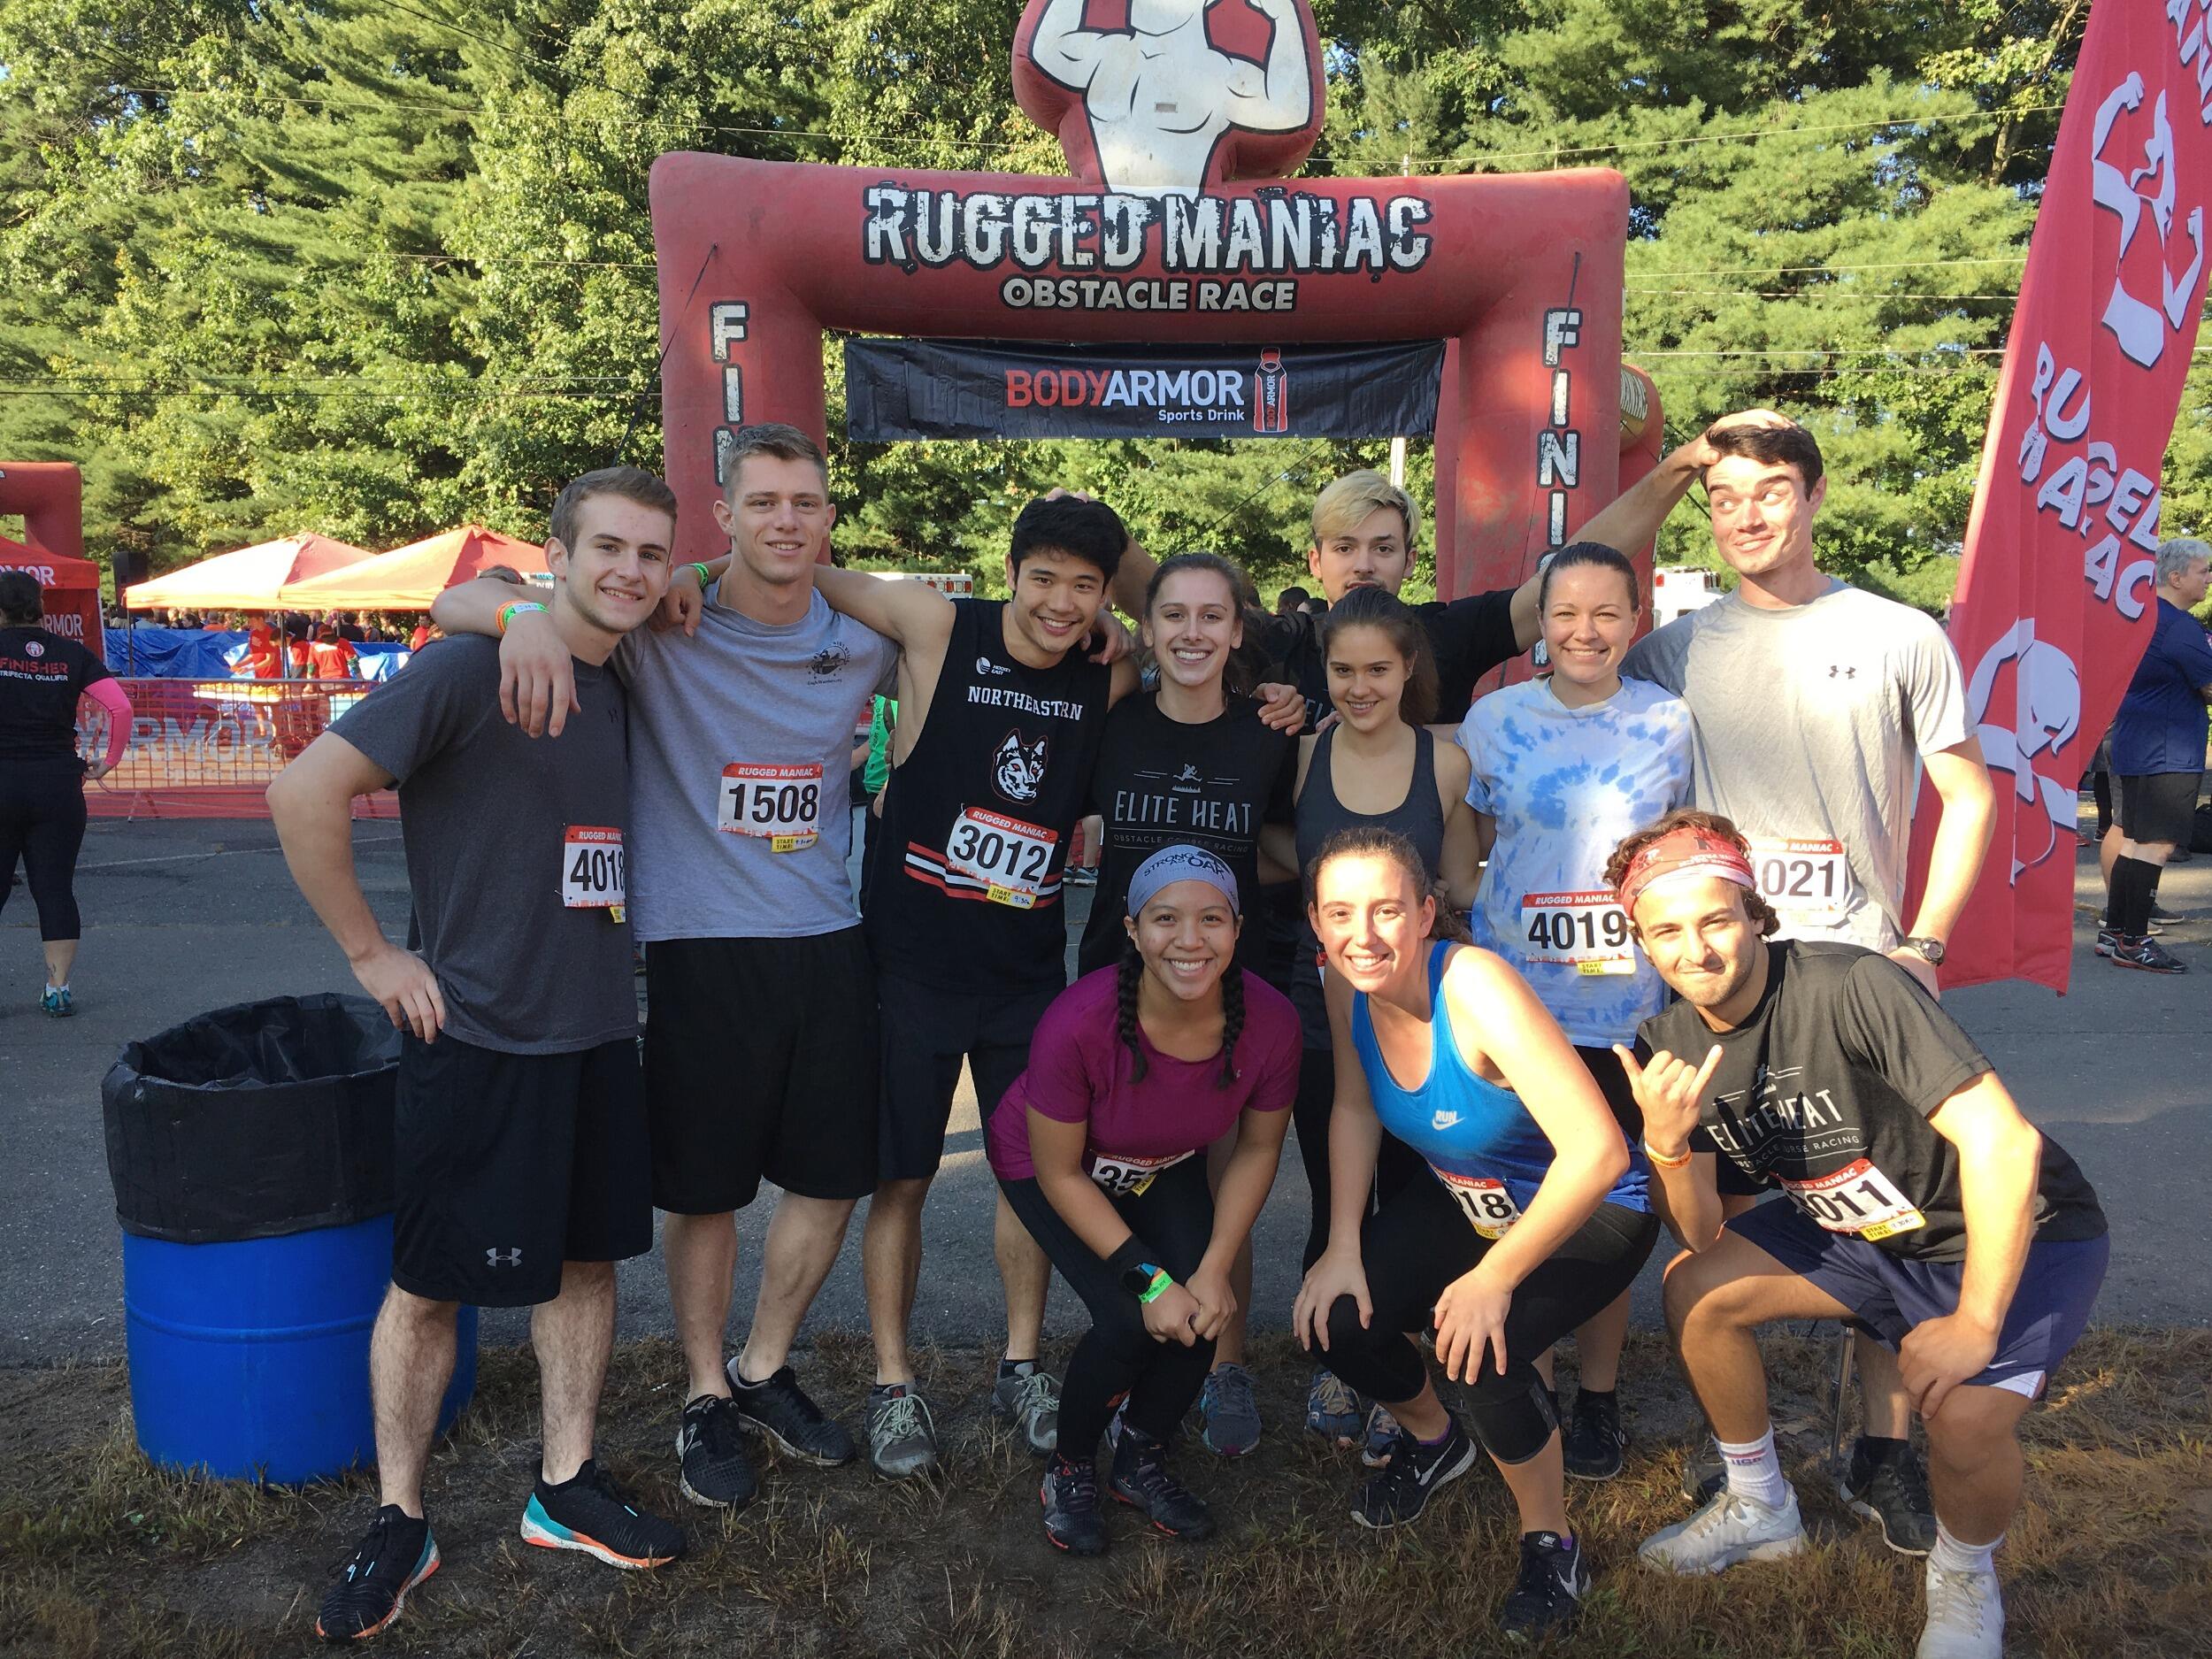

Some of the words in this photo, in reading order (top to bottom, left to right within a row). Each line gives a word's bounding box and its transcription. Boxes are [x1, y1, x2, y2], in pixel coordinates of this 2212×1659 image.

[867, 186, 1155, 269] RUGGED
[1163, 190, 1430, 269] MANIAC
[1002, 277, 1188, 311] OBSTACLE
[1198, 280, 1295, 311] RACE
[1004, 369, 1245, 407] BODYARMOR
[1157, 409, 1203, 424] Sports
[1207, 409, 1245, 422] Drink
[1537, 310, 1580, 665] FINI
[967, 686, 1083, 721] NORTHEASTRN
[738, 766, 777, 777] RUGGED
[779, 767, 814, 777] MANIAC
[728, 783, 818, 824] 1508
[1114, 790, 1179, 824] ELITE
[1192, 799, 1251, 834] HEAT
[579, 831, 606, 841] RUGGED
[972, 810, 1011, 828] RUGGED
[1011, 823, 1048, 839] MANIAC
[953, 824, 1047, 883] 3012
[1113, 833, 1163, 844] OBSTACLE
[1214, 842, 1249, 854] RACING
[1788, 842, 1833, 853] MANIAC
[570, 849, 625, 893] 4018
[1143, 852, 1194, 878] STRONG
[1187, 856, 1225, 881] OAK
[1750, 857, 1834, 898] 021
[992, 887, 1011, 897] START
[1535, 895, 1573, 905] RUGGED
[1574, 895, 1615, 904] MANIAC
[1527, 910, 1628, 950] 4019
[1434, 1110, 1458, 1123] RUN
[1706, 1101, 1781, 1152] ELITE
[1776, 1088, 1843, 1132] HEAT
[1814, 1135, 1860, 1150] RACING
[1111, 1155, 1153, 1167] RUGGED
[1099, 1164, 1161, 1192] 35
[1449, 1176, 1487, 1188] MANIAC
[1815, 1167, 1857, 1189] MANIAC
[1451, 1190, 1512, 1219] 18
[1865, 1225, 1887, 1233] START
